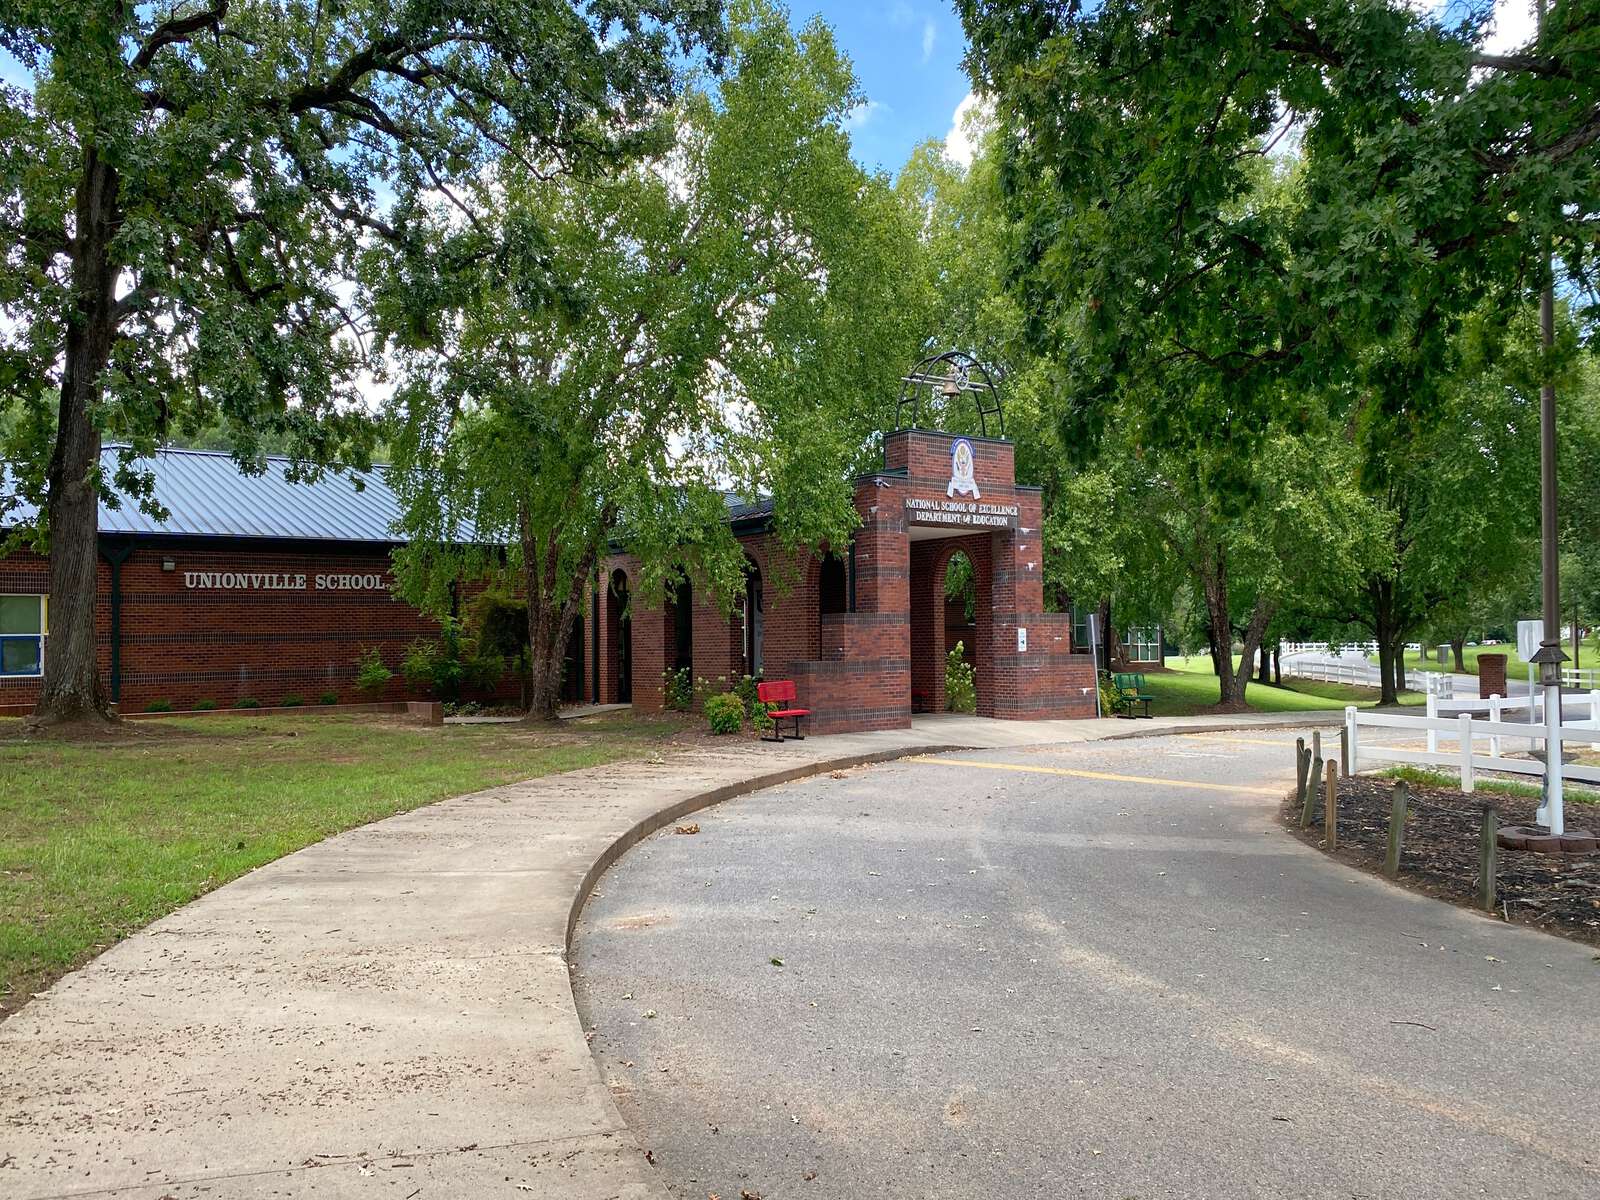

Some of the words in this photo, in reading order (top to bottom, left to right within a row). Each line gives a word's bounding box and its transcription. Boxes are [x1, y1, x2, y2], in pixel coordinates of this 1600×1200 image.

[906, 499, 940, 511] NATIONAL
[941, 502, 967, 513] SCHOOL
[979, 504, 1018, 516] EXCELLENCE
[916, 511, 960, 523] DEPARTMENT
[973, 515, 1008, 526] EDUCATION
[184, 572, 306, 589] UNIONVILLE
[315, 575, 386, 590] SCHOOL
